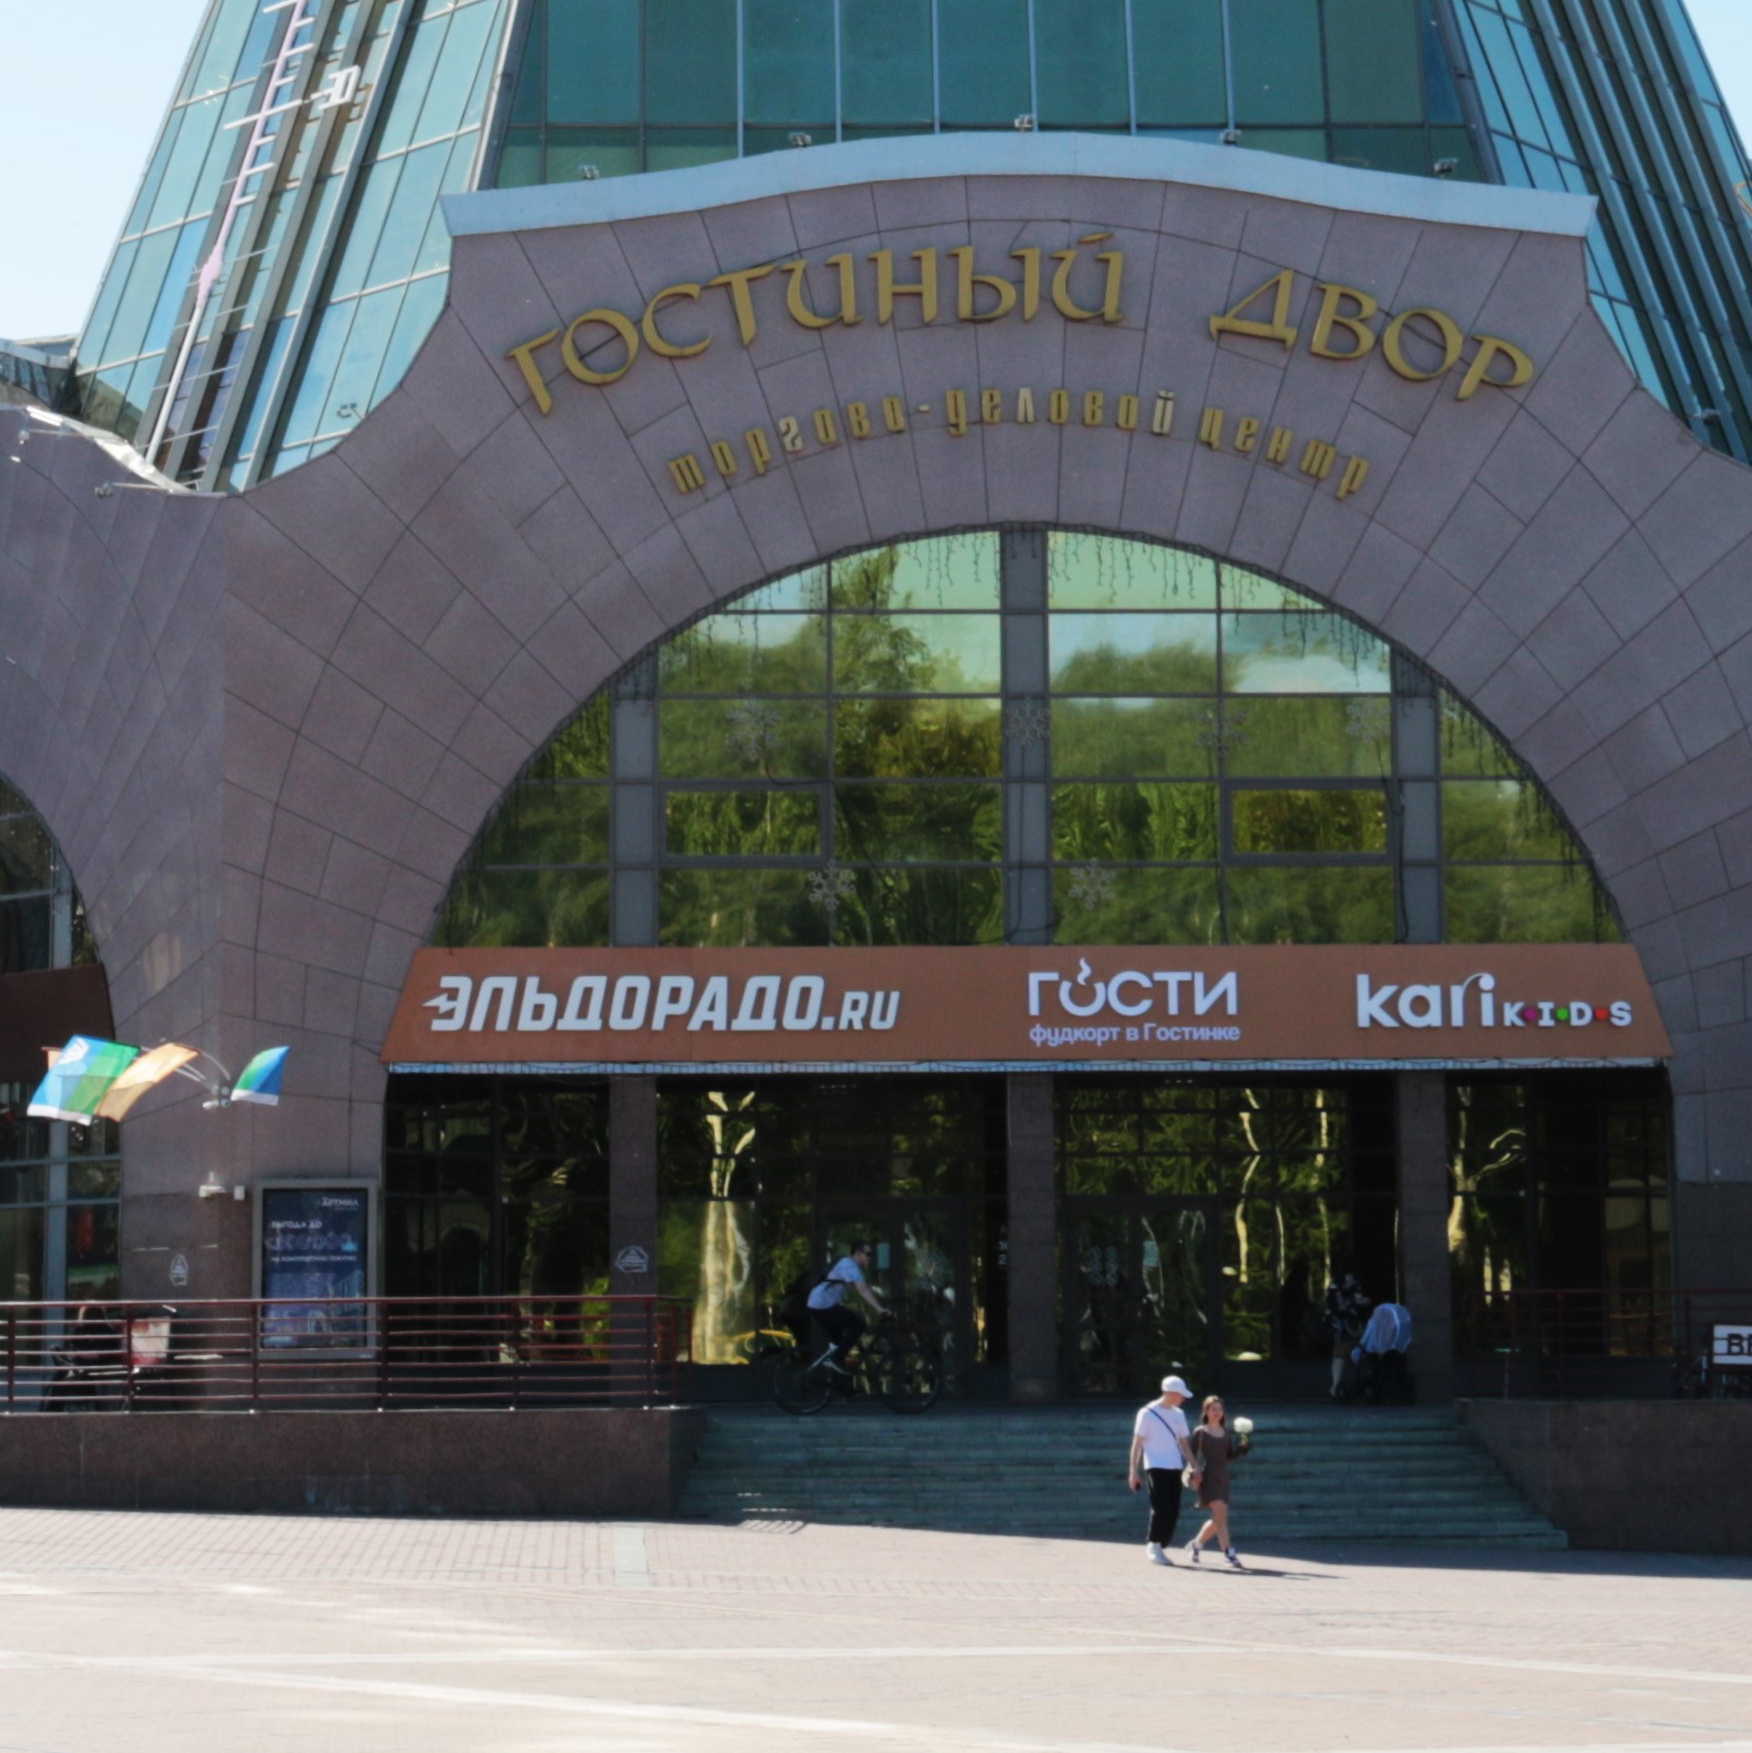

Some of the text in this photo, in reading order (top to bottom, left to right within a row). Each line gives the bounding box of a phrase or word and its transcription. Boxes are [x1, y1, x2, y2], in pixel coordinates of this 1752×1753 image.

[505, 232, 1535, 416] ГОСТИНЫЙ ДВОР
[1200, 405, 1369, 500] центр
[1027, 960, 1239, 1017] ГОСТИ
[1356, 972, 1496, 1029] kari
[1029, 1023, 1241, 1047] фудкорт в Гостинке
